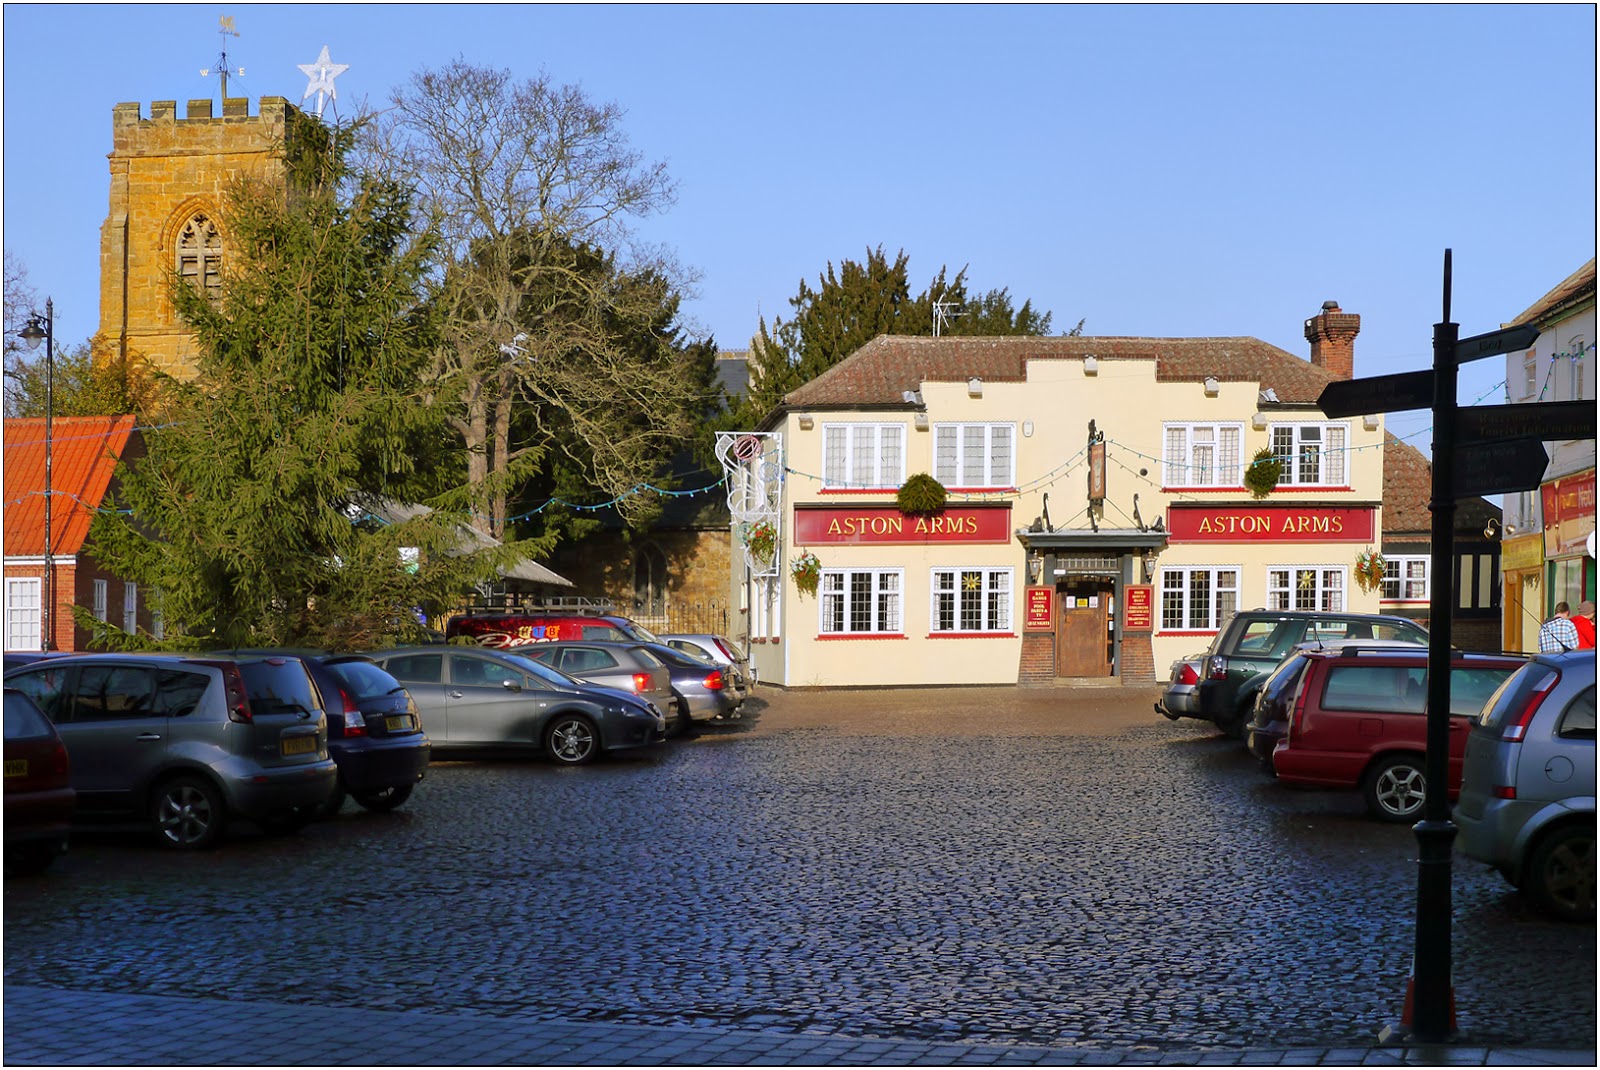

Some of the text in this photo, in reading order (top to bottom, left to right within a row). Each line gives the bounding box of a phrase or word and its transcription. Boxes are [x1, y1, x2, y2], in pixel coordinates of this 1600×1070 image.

[239, 68, 245, 76] E
[827, 515, 979, 536] ASTON ARMS
[1198, 515, 1344, 534] ASTON ARMS
